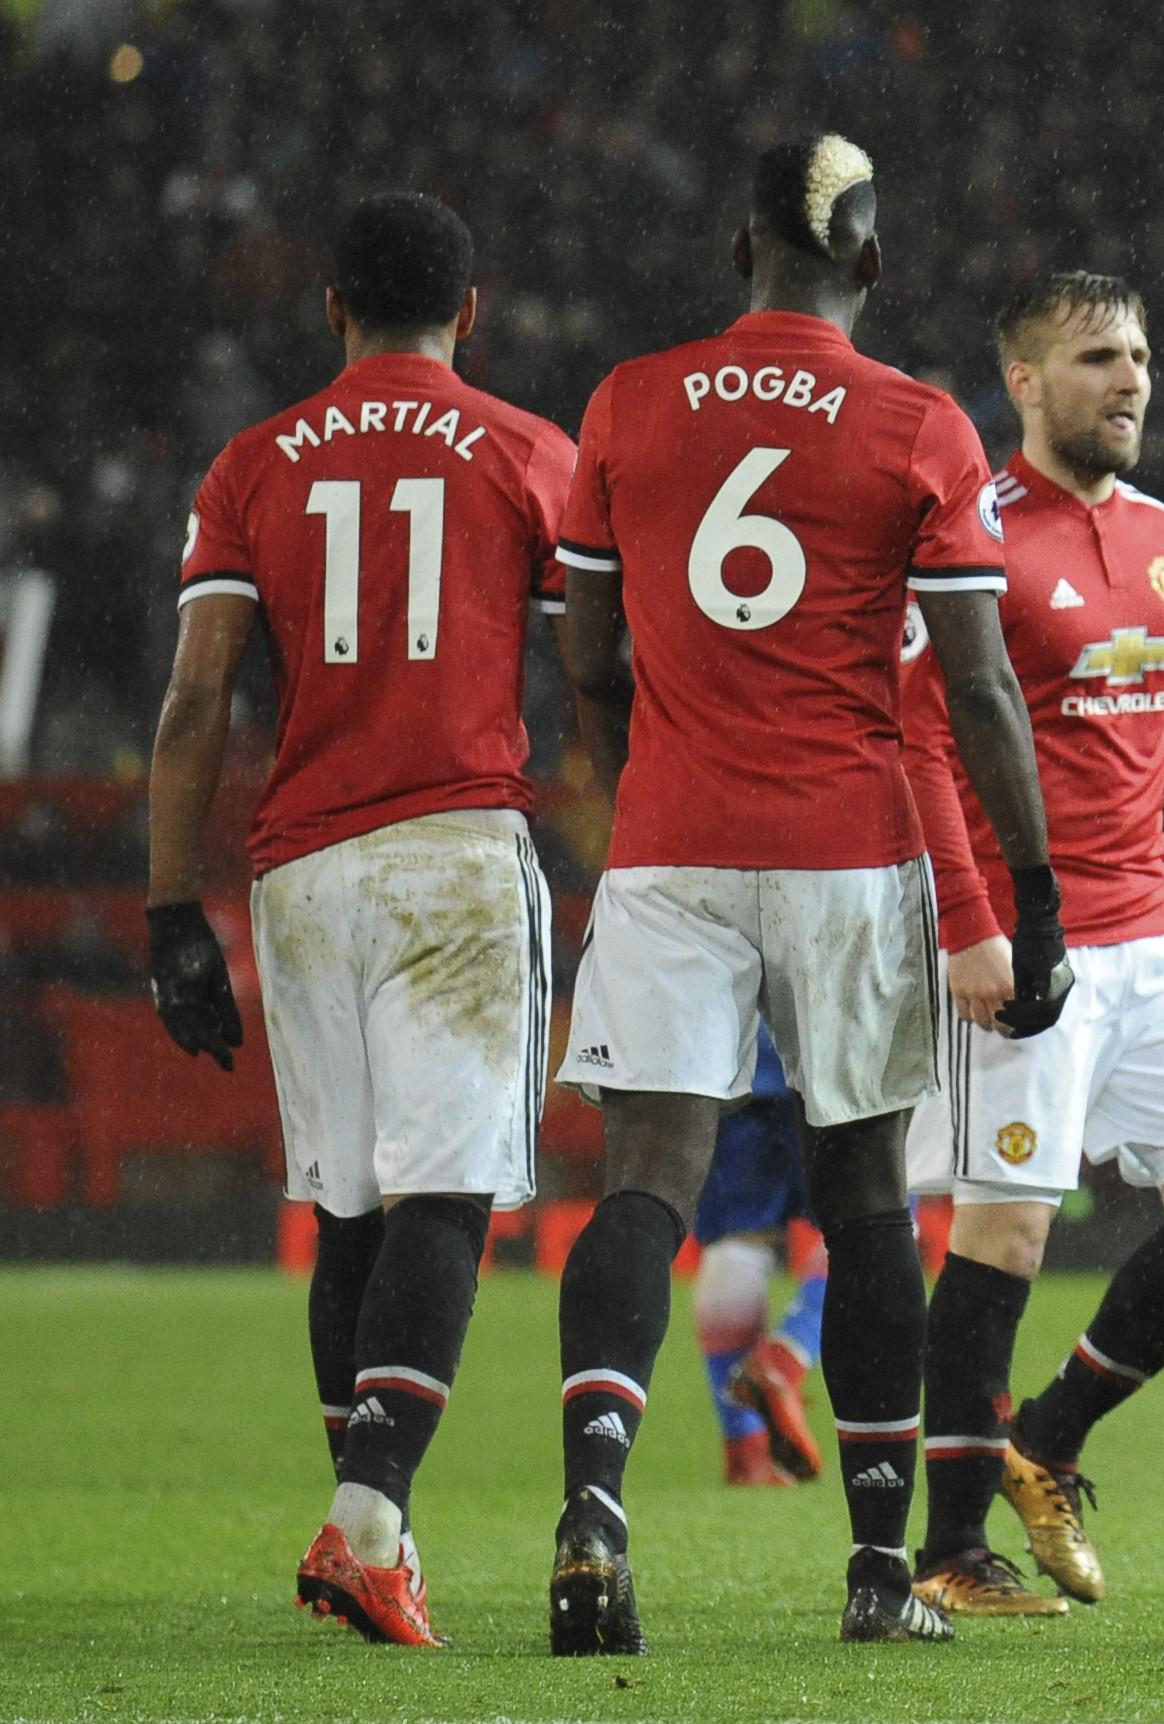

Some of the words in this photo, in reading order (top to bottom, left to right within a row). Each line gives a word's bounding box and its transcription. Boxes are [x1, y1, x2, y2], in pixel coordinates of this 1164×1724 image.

[683, 365, 847, 424] POGBA
[275, 400, 486, 463] MARTIAL
[688, 446, 807, 630] 6
[305, 477, 445, 664] 11
[583, 1425, 631, 1449] adidas
[851, 1477, 905, 1489] adidas
